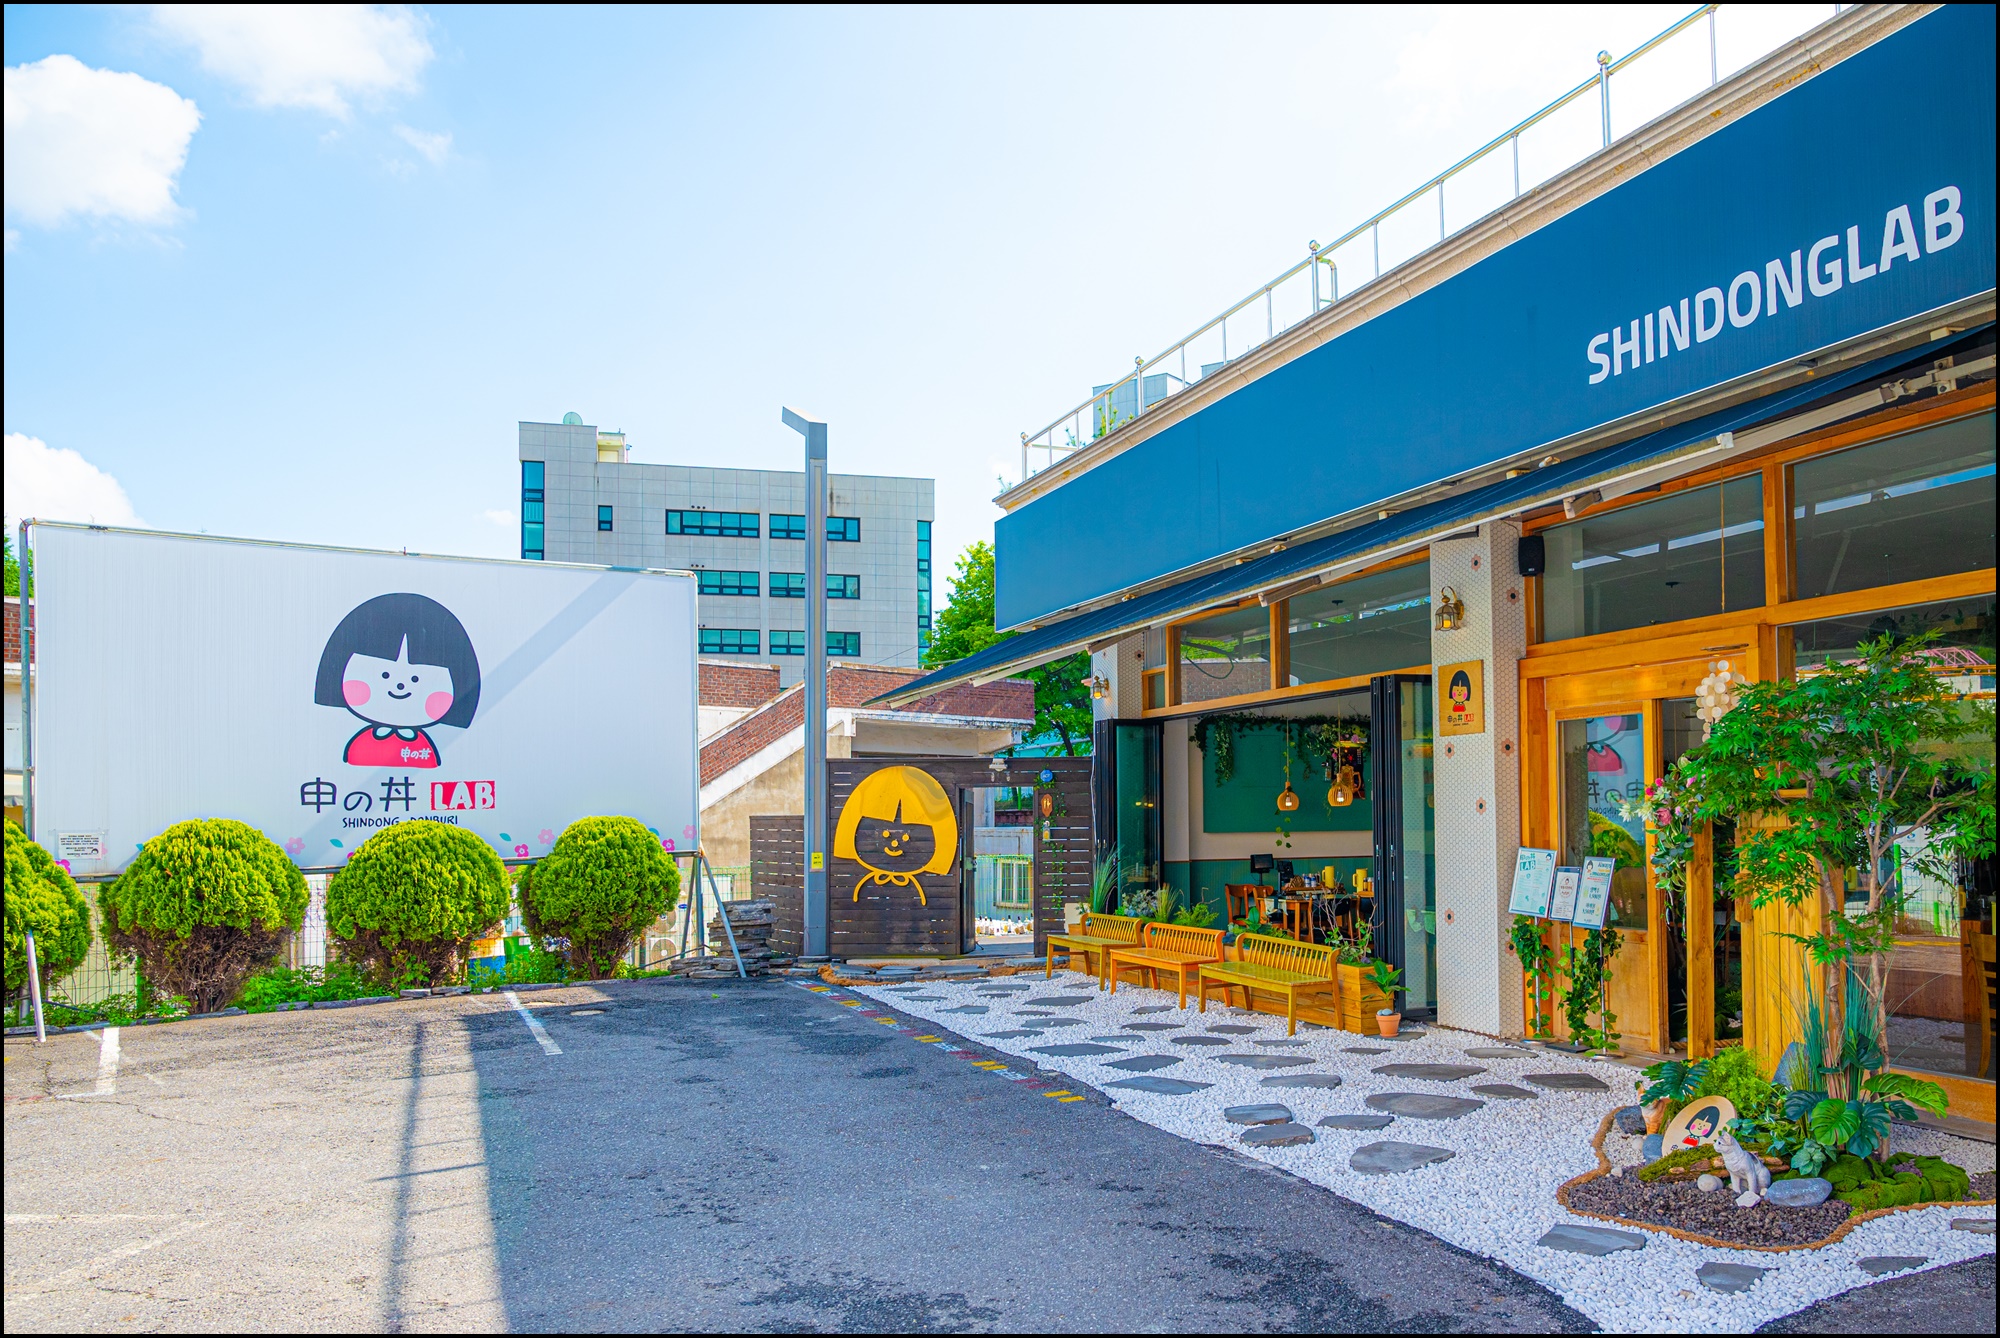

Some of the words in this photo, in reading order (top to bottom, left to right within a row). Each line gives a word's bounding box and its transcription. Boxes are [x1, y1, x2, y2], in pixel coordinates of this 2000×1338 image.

[1587, 185, 1964, 385] SHINDONGLAB
[400, 746, 432, 762] 申の丼
[300, 776, 417, 813] 申の丼
[433, 781, 495, 810] LAB
[342, 817, 400, 828] SHINDONG
